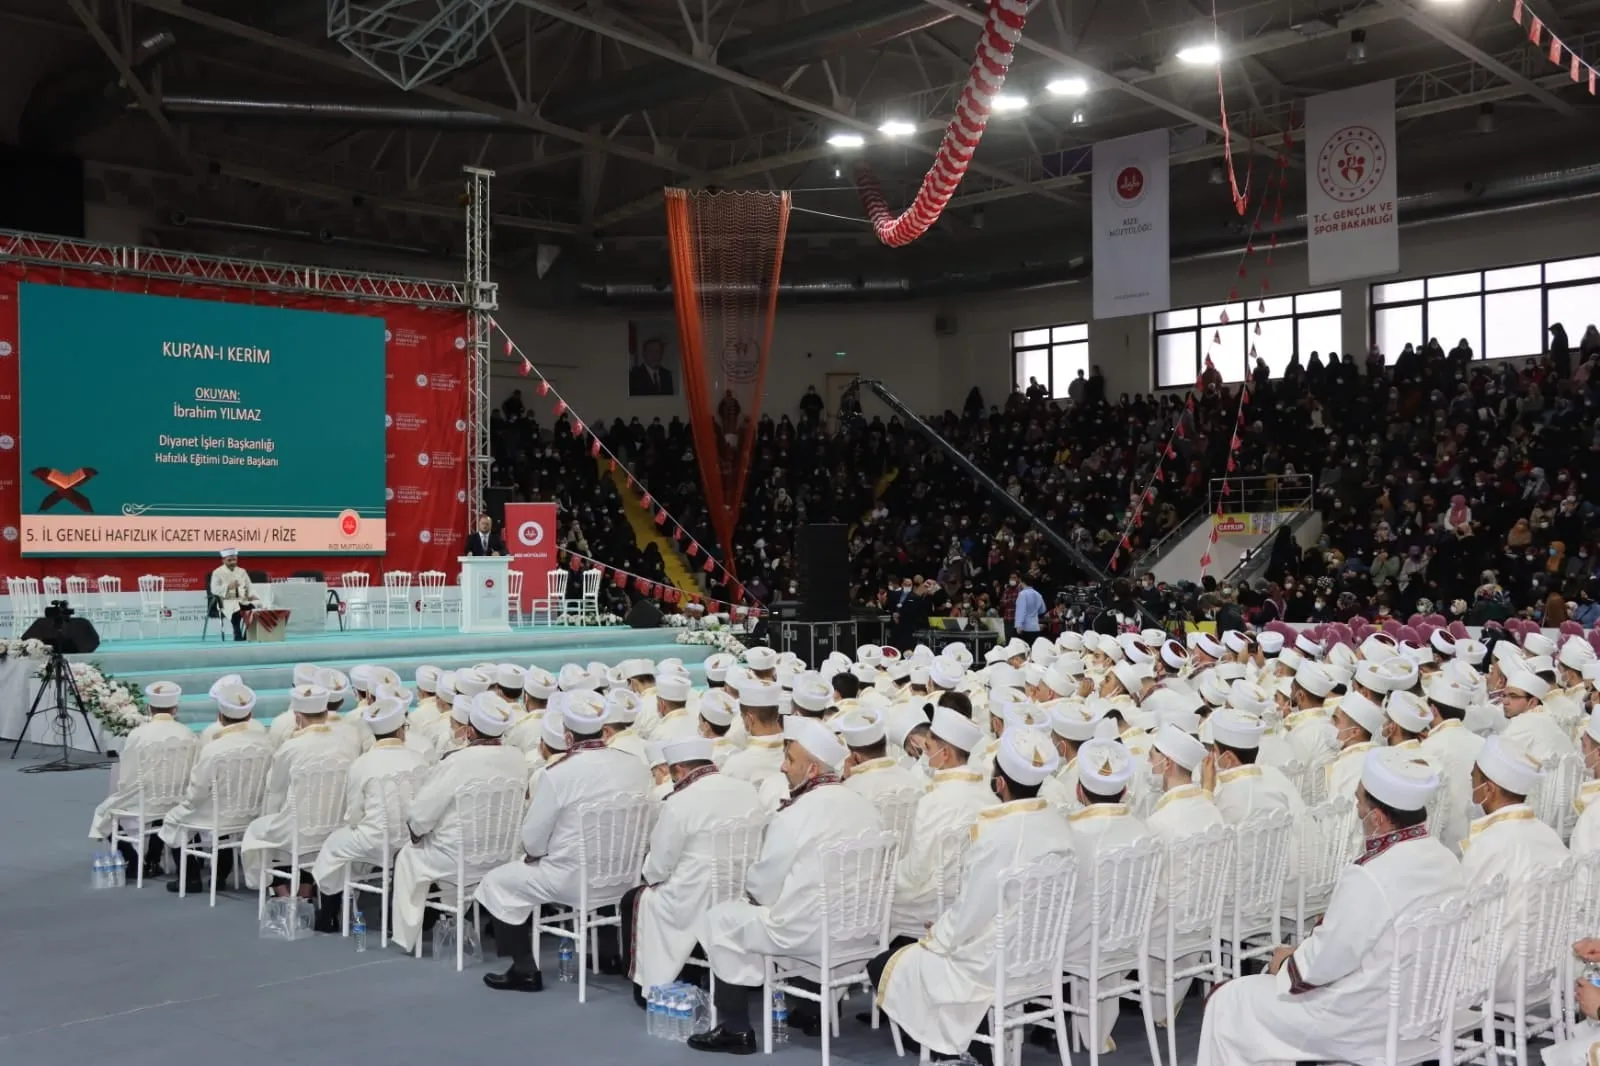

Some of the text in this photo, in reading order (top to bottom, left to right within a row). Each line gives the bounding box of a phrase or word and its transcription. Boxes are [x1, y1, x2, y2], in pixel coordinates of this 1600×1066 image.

[1333, 203, 1376, 221] GENÇLİK
[1380, 201, 1393, 212] VE
[1314, 213, 1393, 236] SPOR BAKANLIĞI
[227, 345, 270, 364] KERİM
[195, 387, 241, 401] OKUYAN:
[173, 401, 262, 421] İbrahim YILMAZ
[159, 434, 275, 452] Diyanet İşleri Başkanlığı
[155, 452, 279, 468] Hafızlık Eğitimi Daire Başkanı
[26, 528, 38, 542] 5.
[42, 525, 53, 542] İL
[56, 526, 102, 542] GENELİ
[105, 529, 157, 542] HAFIZLIK
[160, 525, 200, 542] İCAZET
[203, 527, 261, 543] MERASİMİ
[271, 525, 297, 542] RİZE
